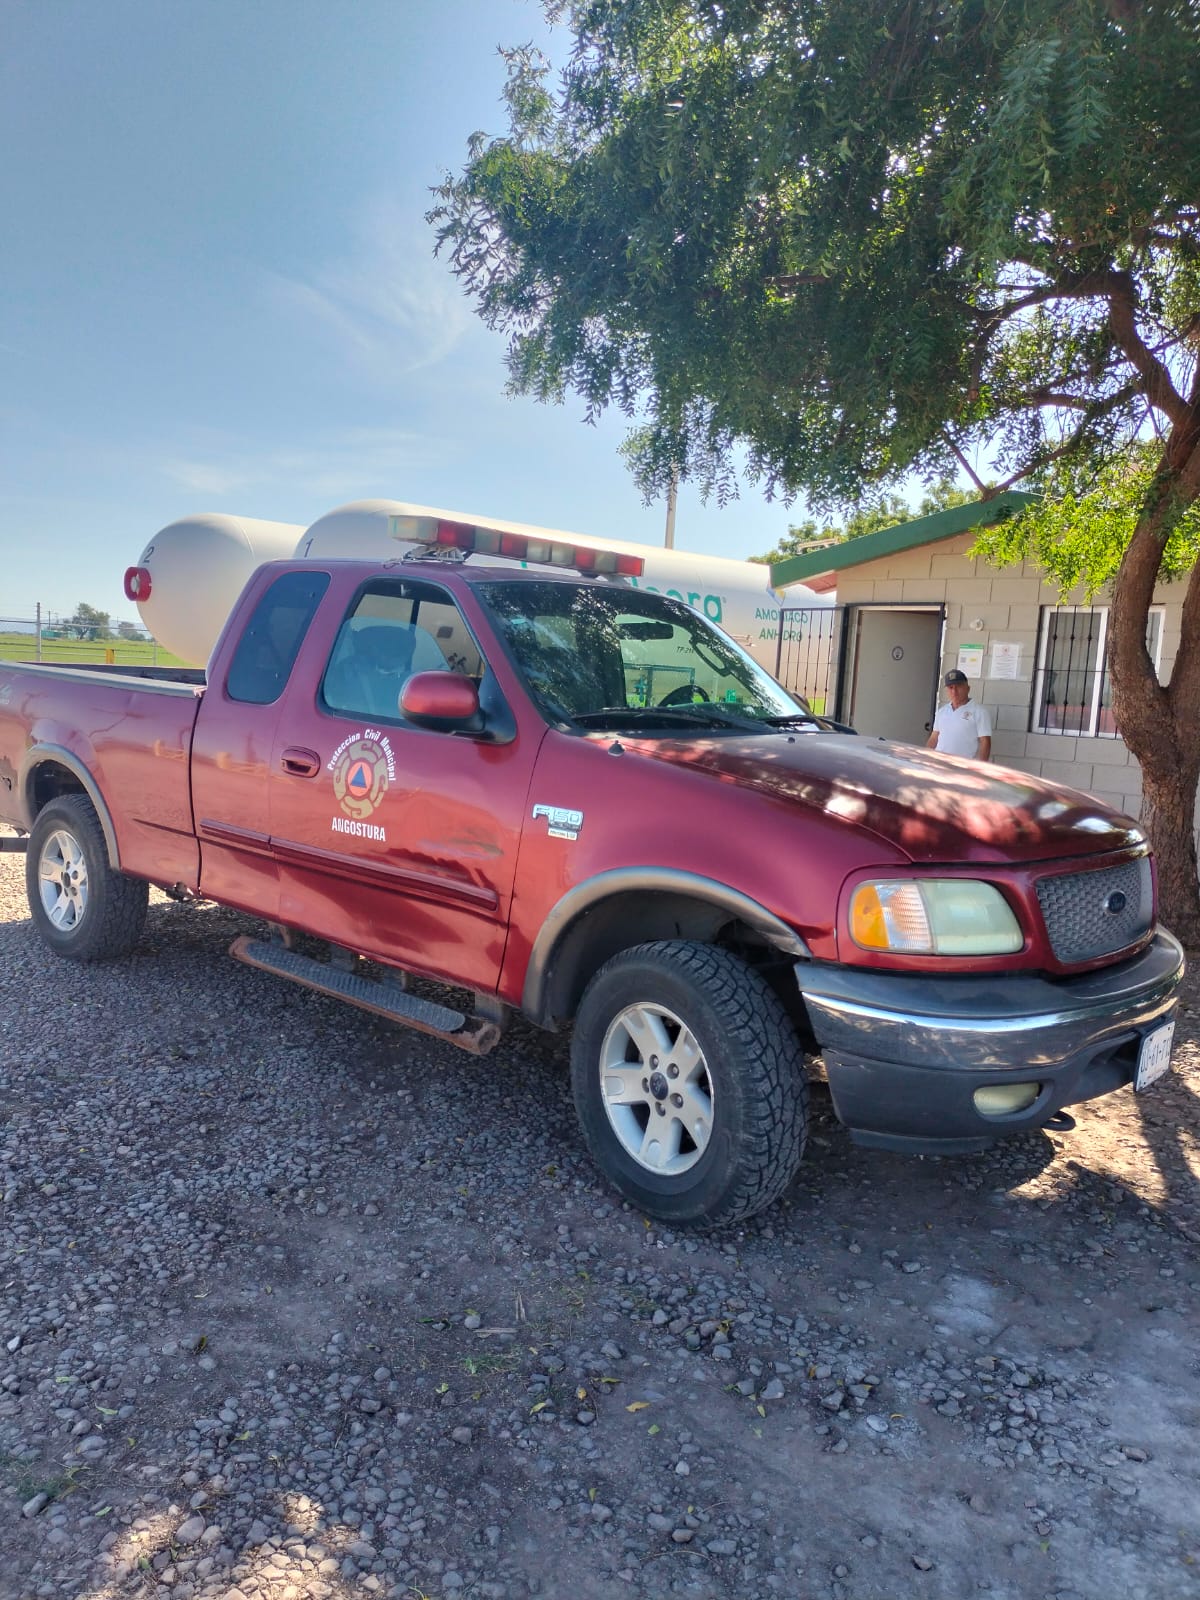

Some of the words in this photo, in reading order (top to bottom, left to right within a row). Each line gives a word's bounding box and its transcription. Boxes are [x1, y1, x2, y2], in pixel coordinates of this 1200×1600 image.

[143, 546, 155, 563] 2
[755, 607, 809, 624] AMOIACO
[327, 732, 361, 771] Proteccion
[364, 728, 381, 742] Civil
[380, 736, 397, 781] Municipal
[331, 816, 387, 842] ANGOSTURA
